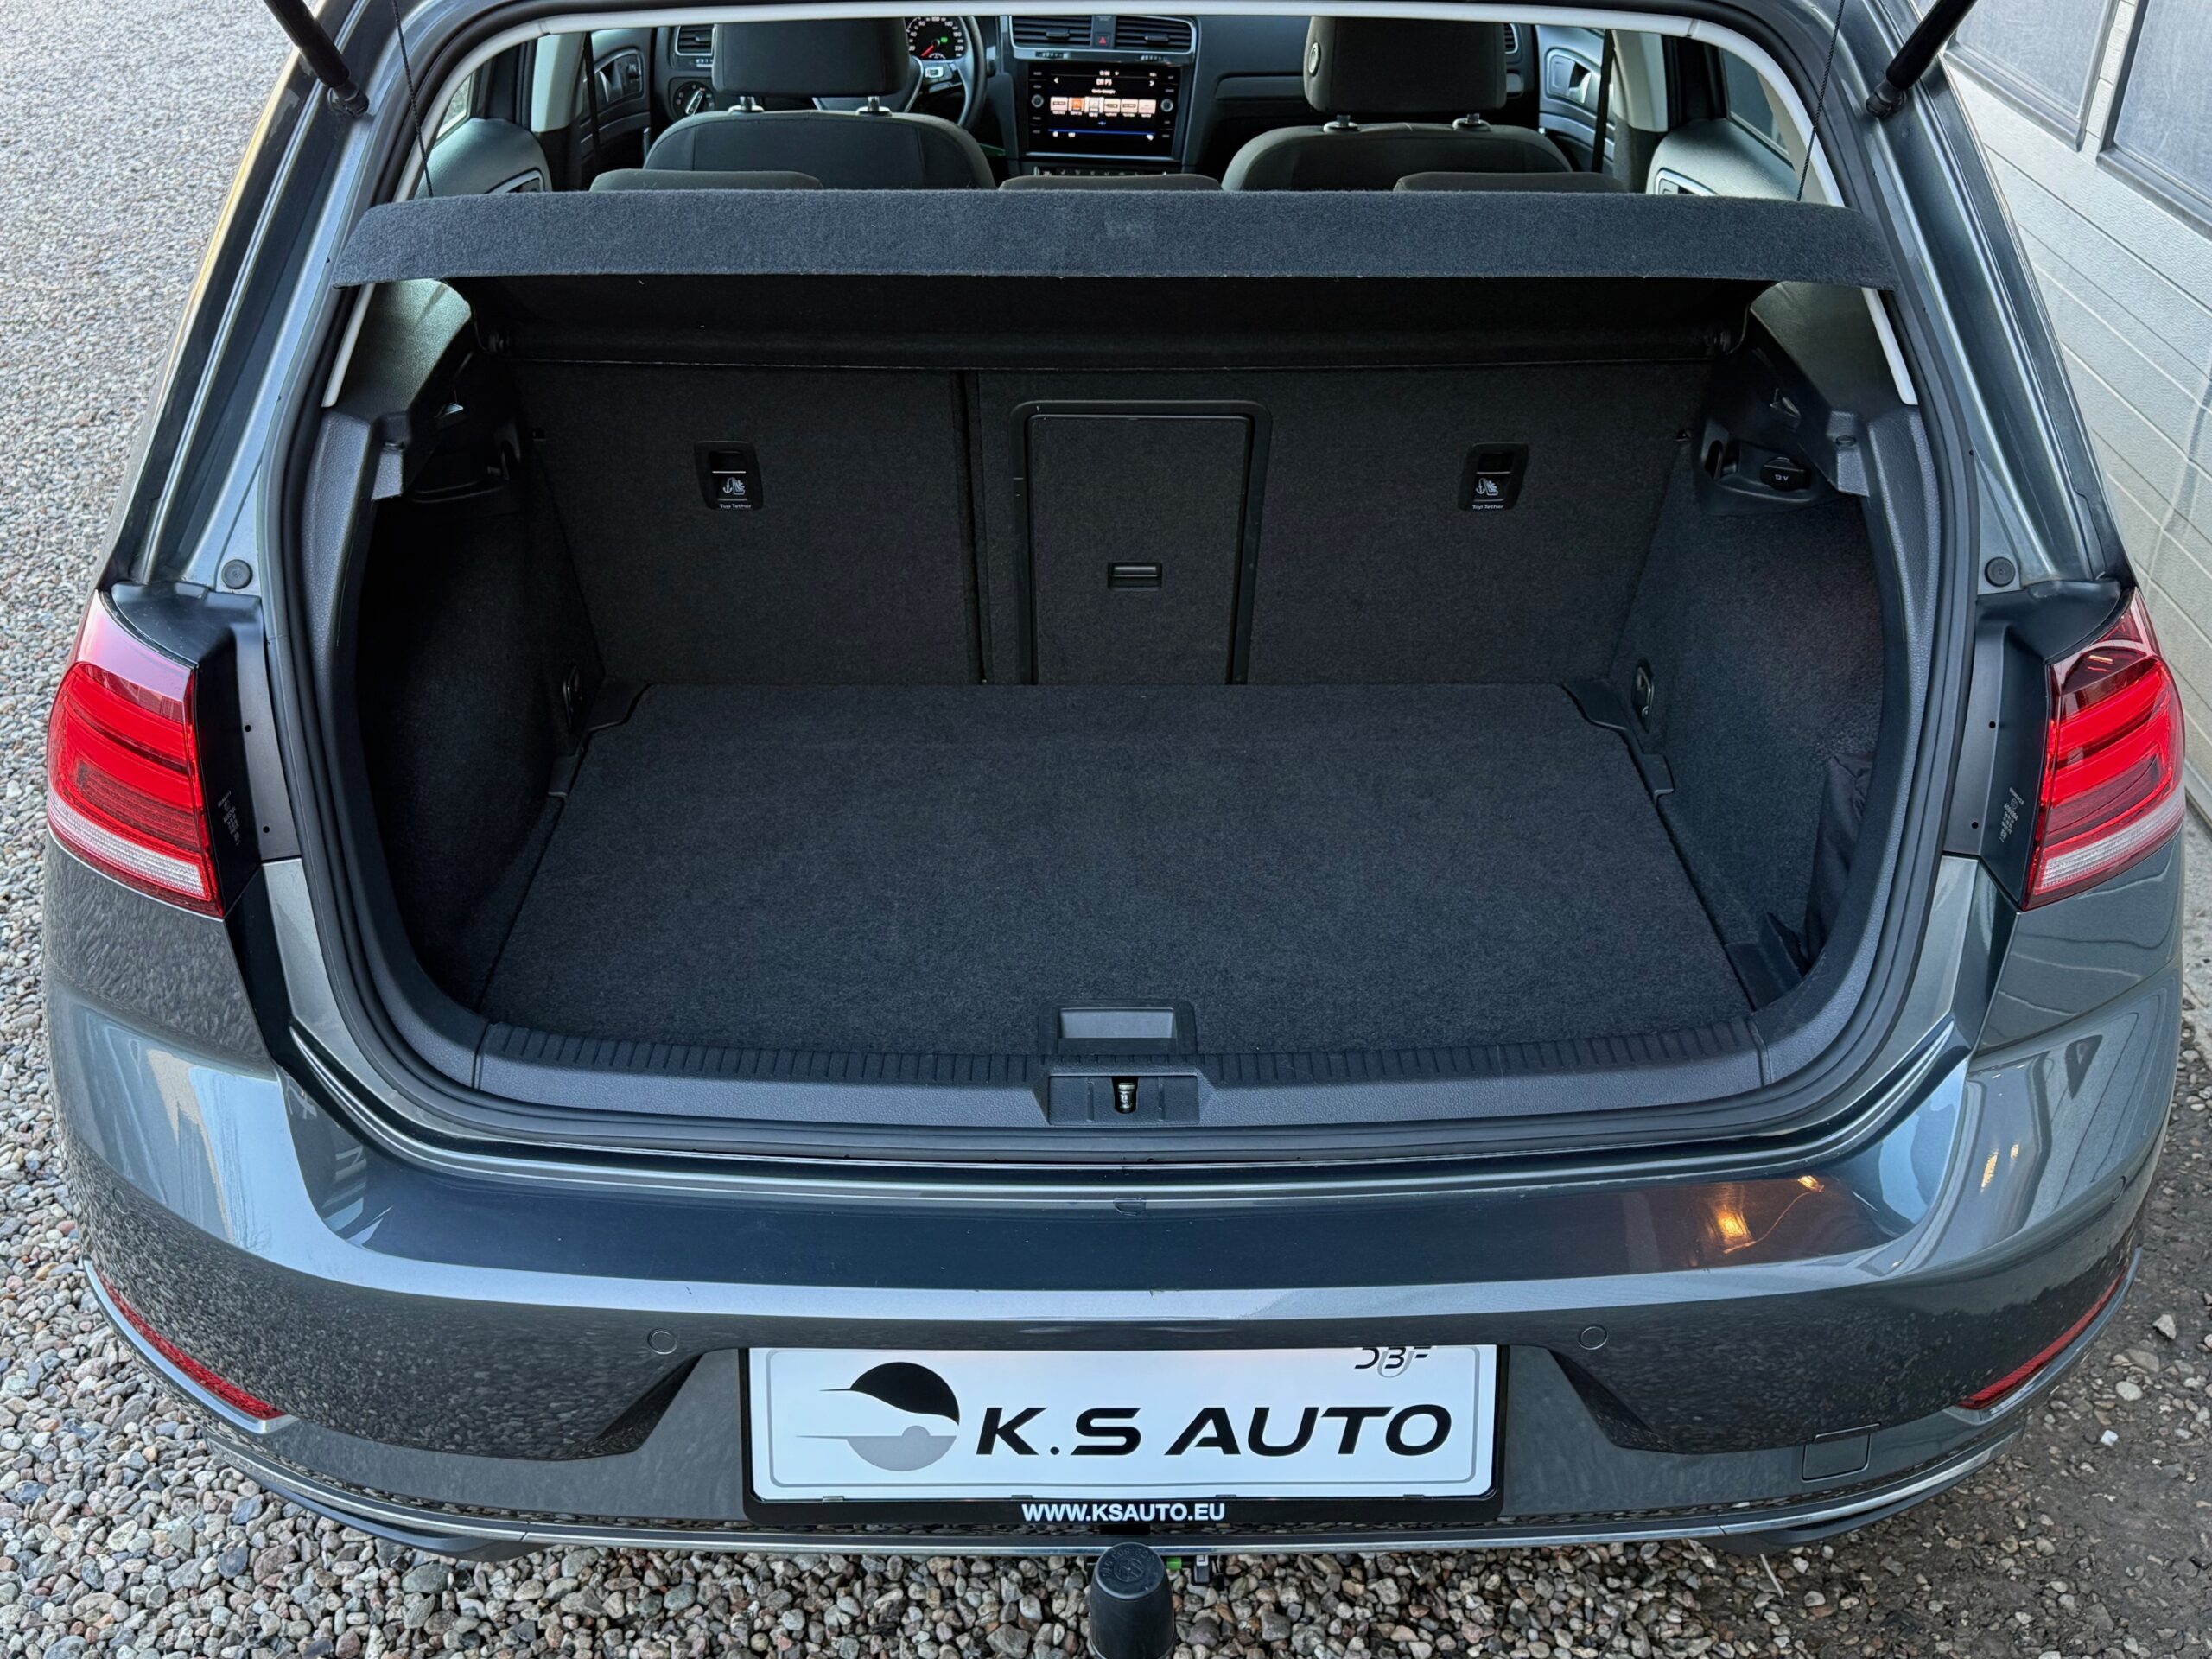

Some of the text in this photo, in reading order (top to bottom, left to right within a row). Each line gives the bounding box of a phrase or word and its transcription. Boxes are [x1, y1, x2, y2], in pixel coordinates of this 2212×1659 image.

[976, 1404, 1452, 1456] K.S AUTO
[1021, 1503, 1224, 1522] WWW.KSAUTO.EU
